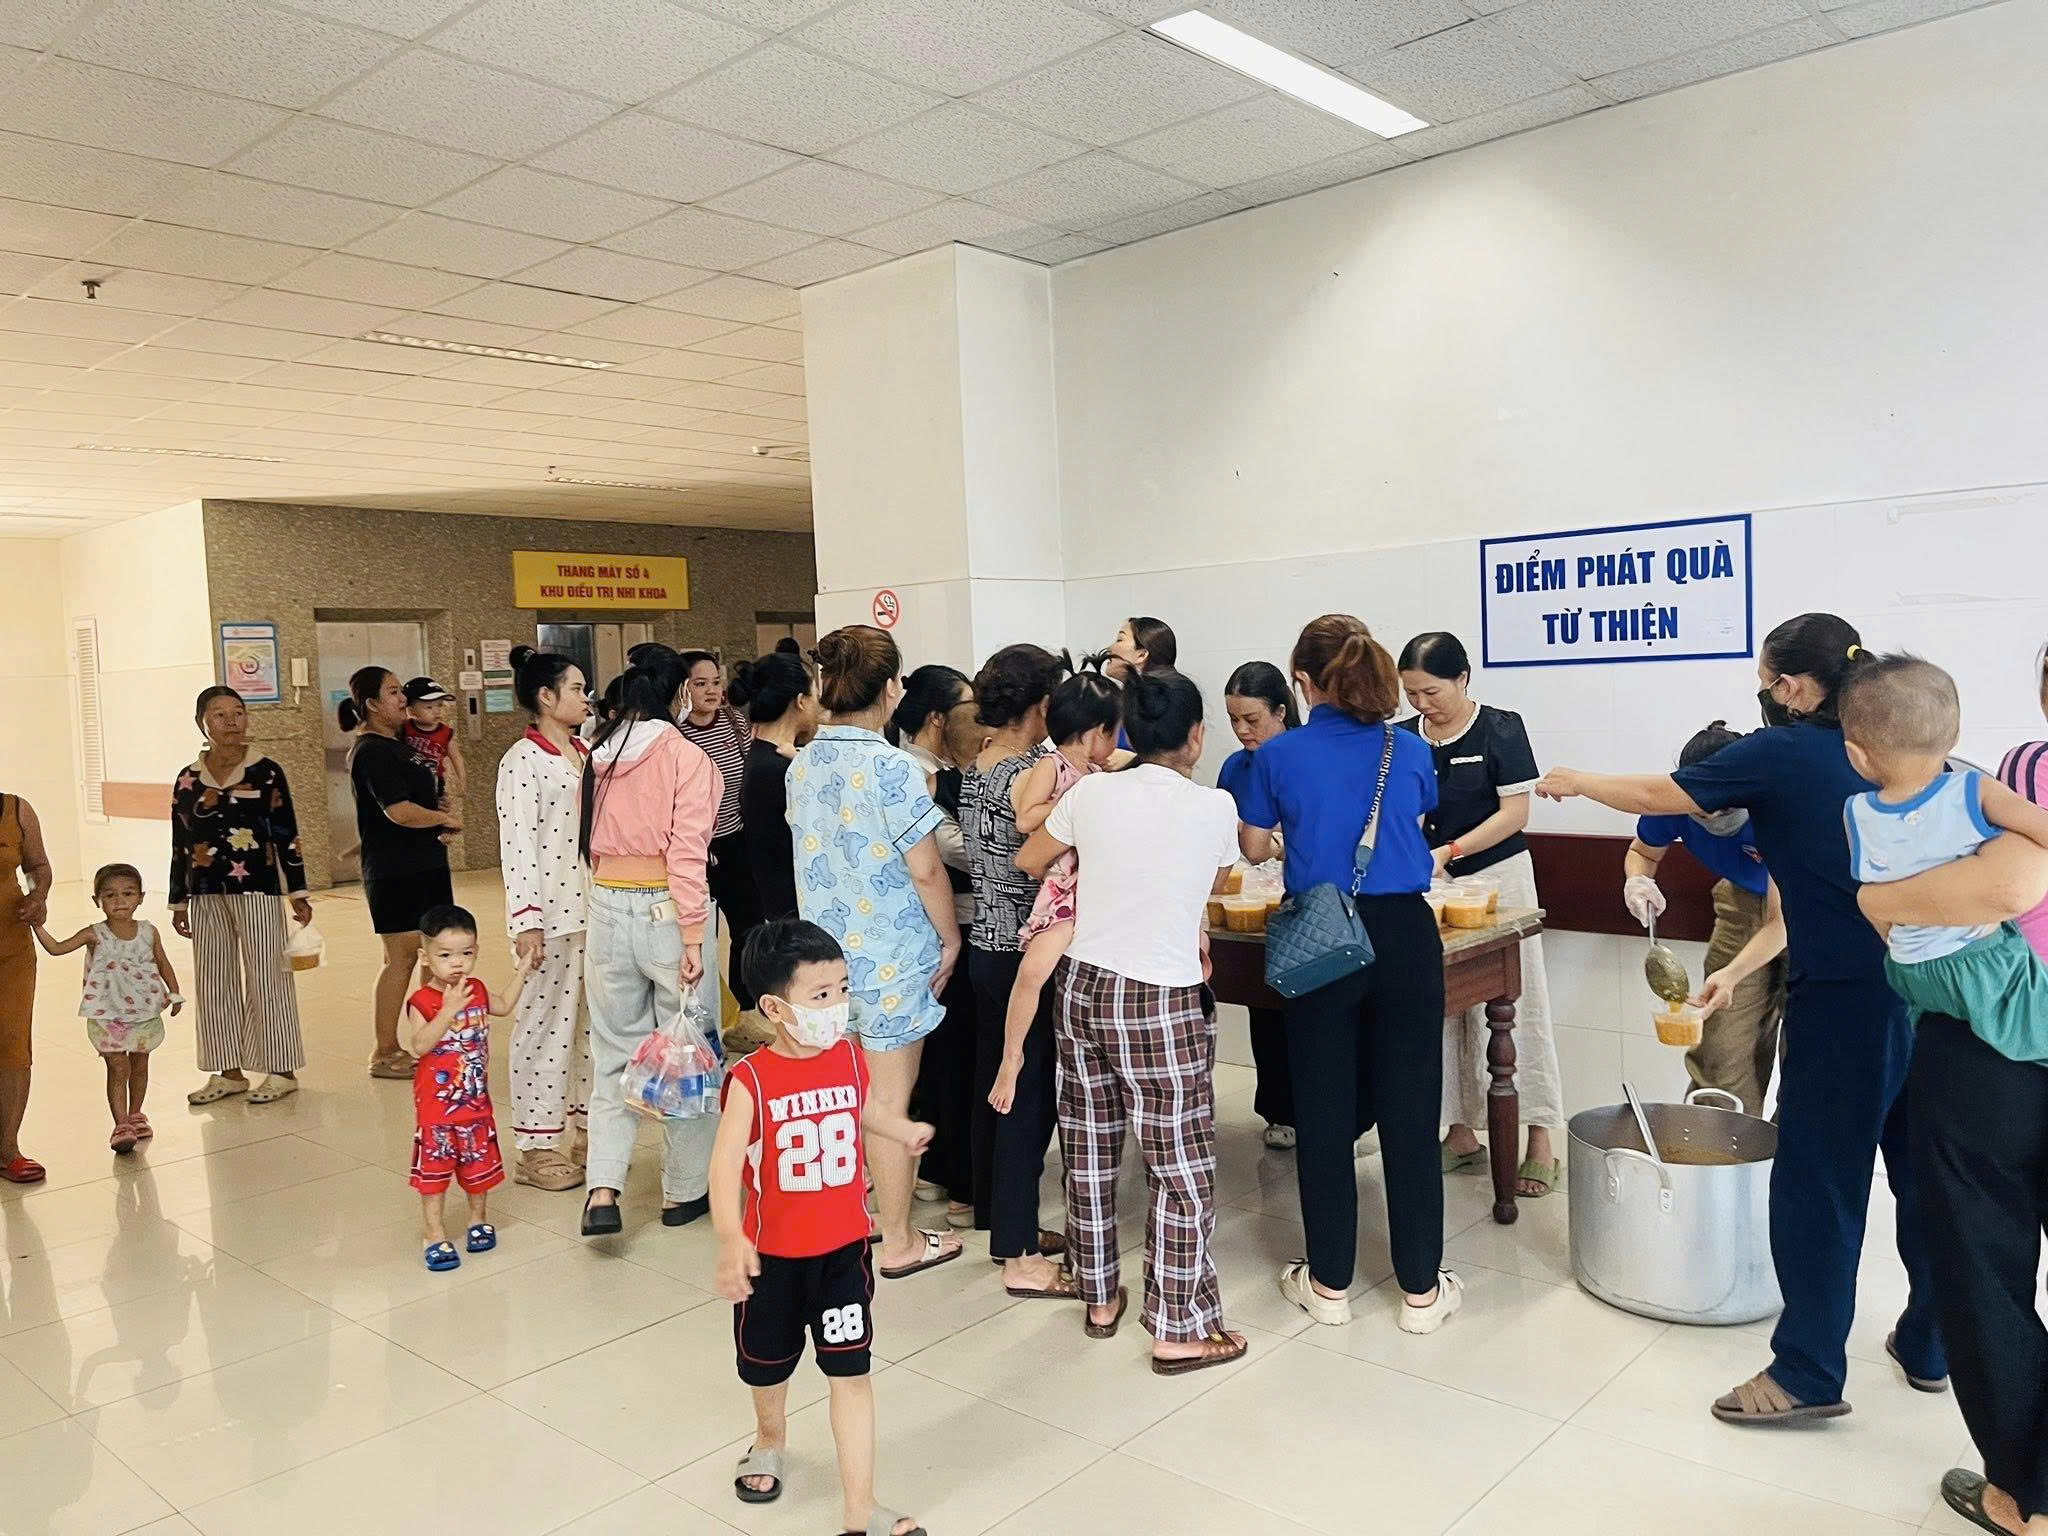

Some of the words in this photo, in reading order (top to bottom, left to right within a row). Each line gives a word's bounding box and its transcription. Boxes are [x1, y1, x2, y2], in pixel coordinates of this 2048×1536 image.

[557, 565, 595, 578] THANG
[626, 563, 640, 579] SỐ
[643, 568, 650, 580] 4
[1494, 549, 1566, 595] ĐIỂM
[1577, 547, 1656, 588] PHÁT
[1666, 539, 1734, 584] QUÀ
[540, 585, 564, 597] KHU
[597, 586, 614, 601] TRỊ
[617, 587, 636, 599] NHI
[638, 587, 667, 600] KHOA
[1542, 607, 1583, 645] TỪ
[1589, 602, 1679, 646] THIỆN
[767, 1085, 857, 1122] WINNER
[775, 1112, 857, 1192] 28
[822, 1303, 864, 1344] 28
